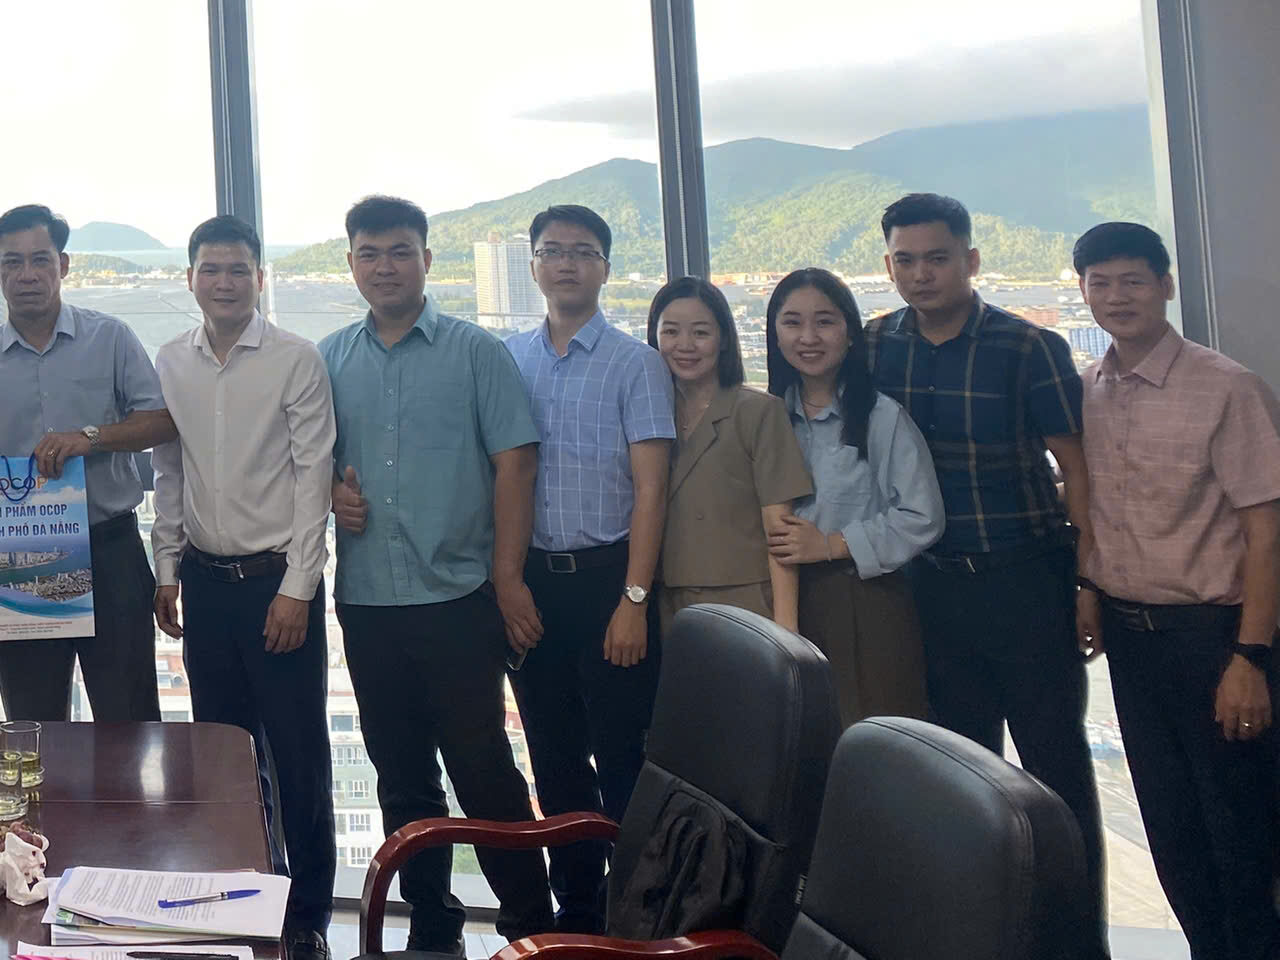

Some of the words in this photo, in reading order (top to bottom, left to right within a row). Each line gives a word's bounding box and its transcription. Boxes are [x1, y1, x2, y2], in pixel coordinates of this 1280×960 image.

[5, 501, 36, 517] PHẨM
[40, 504, 67, 516] OCOP
[8, 521, 29, 536] PHỐ
[50, 519, 80, 535] NẴNG
